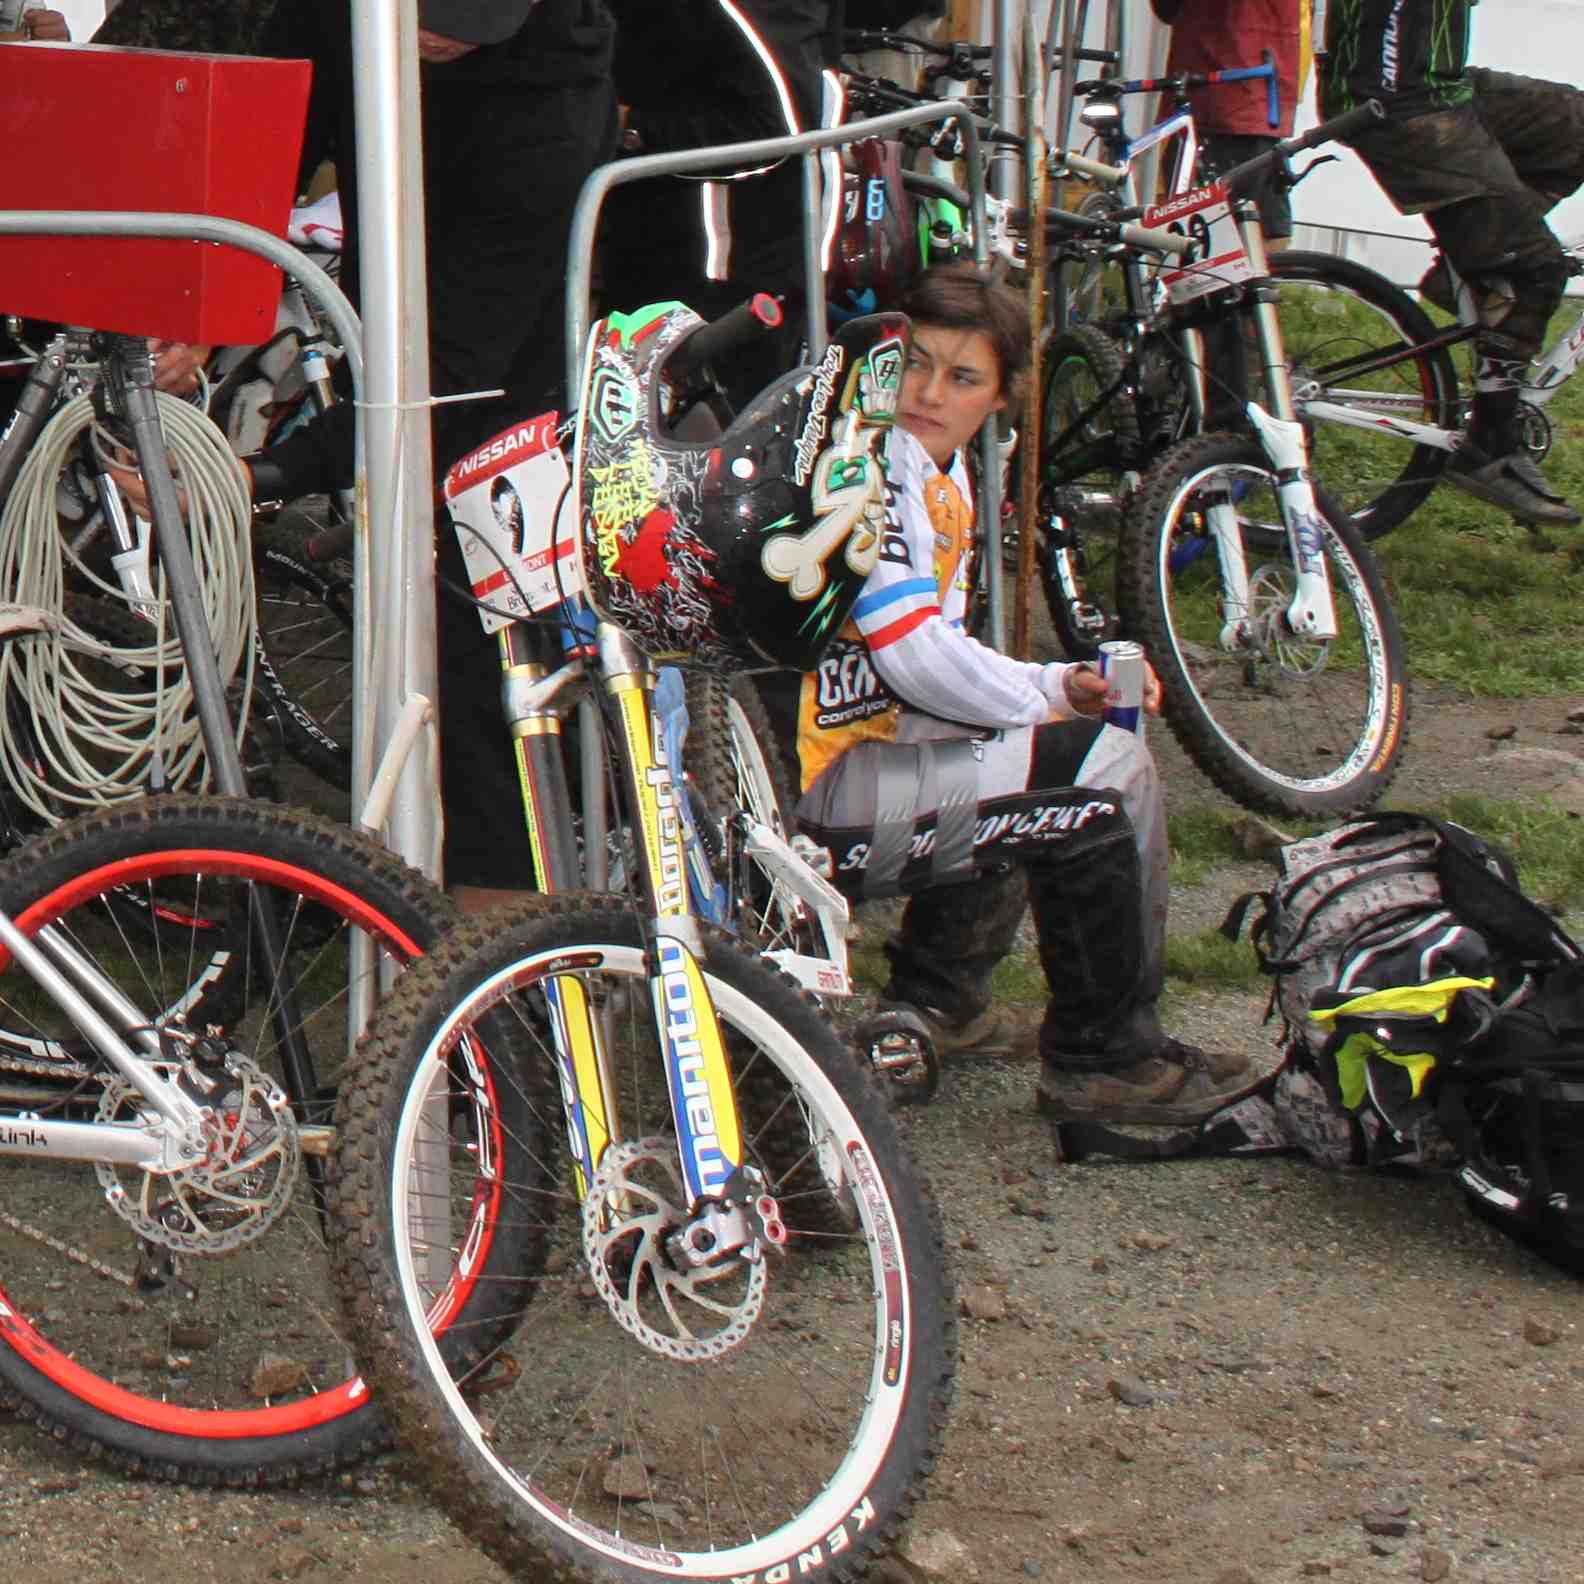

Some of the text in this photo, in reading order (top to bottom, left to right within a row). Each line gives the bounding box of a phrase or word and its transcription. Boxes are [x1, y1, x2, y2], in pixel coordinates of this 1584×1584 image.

[1153, 190, 1211, 219] NISSAN
[459, 424, 536, 478] NISSAN
[490, 475, 525, 555] 9
[657, 943, 726, 1195] manitou
